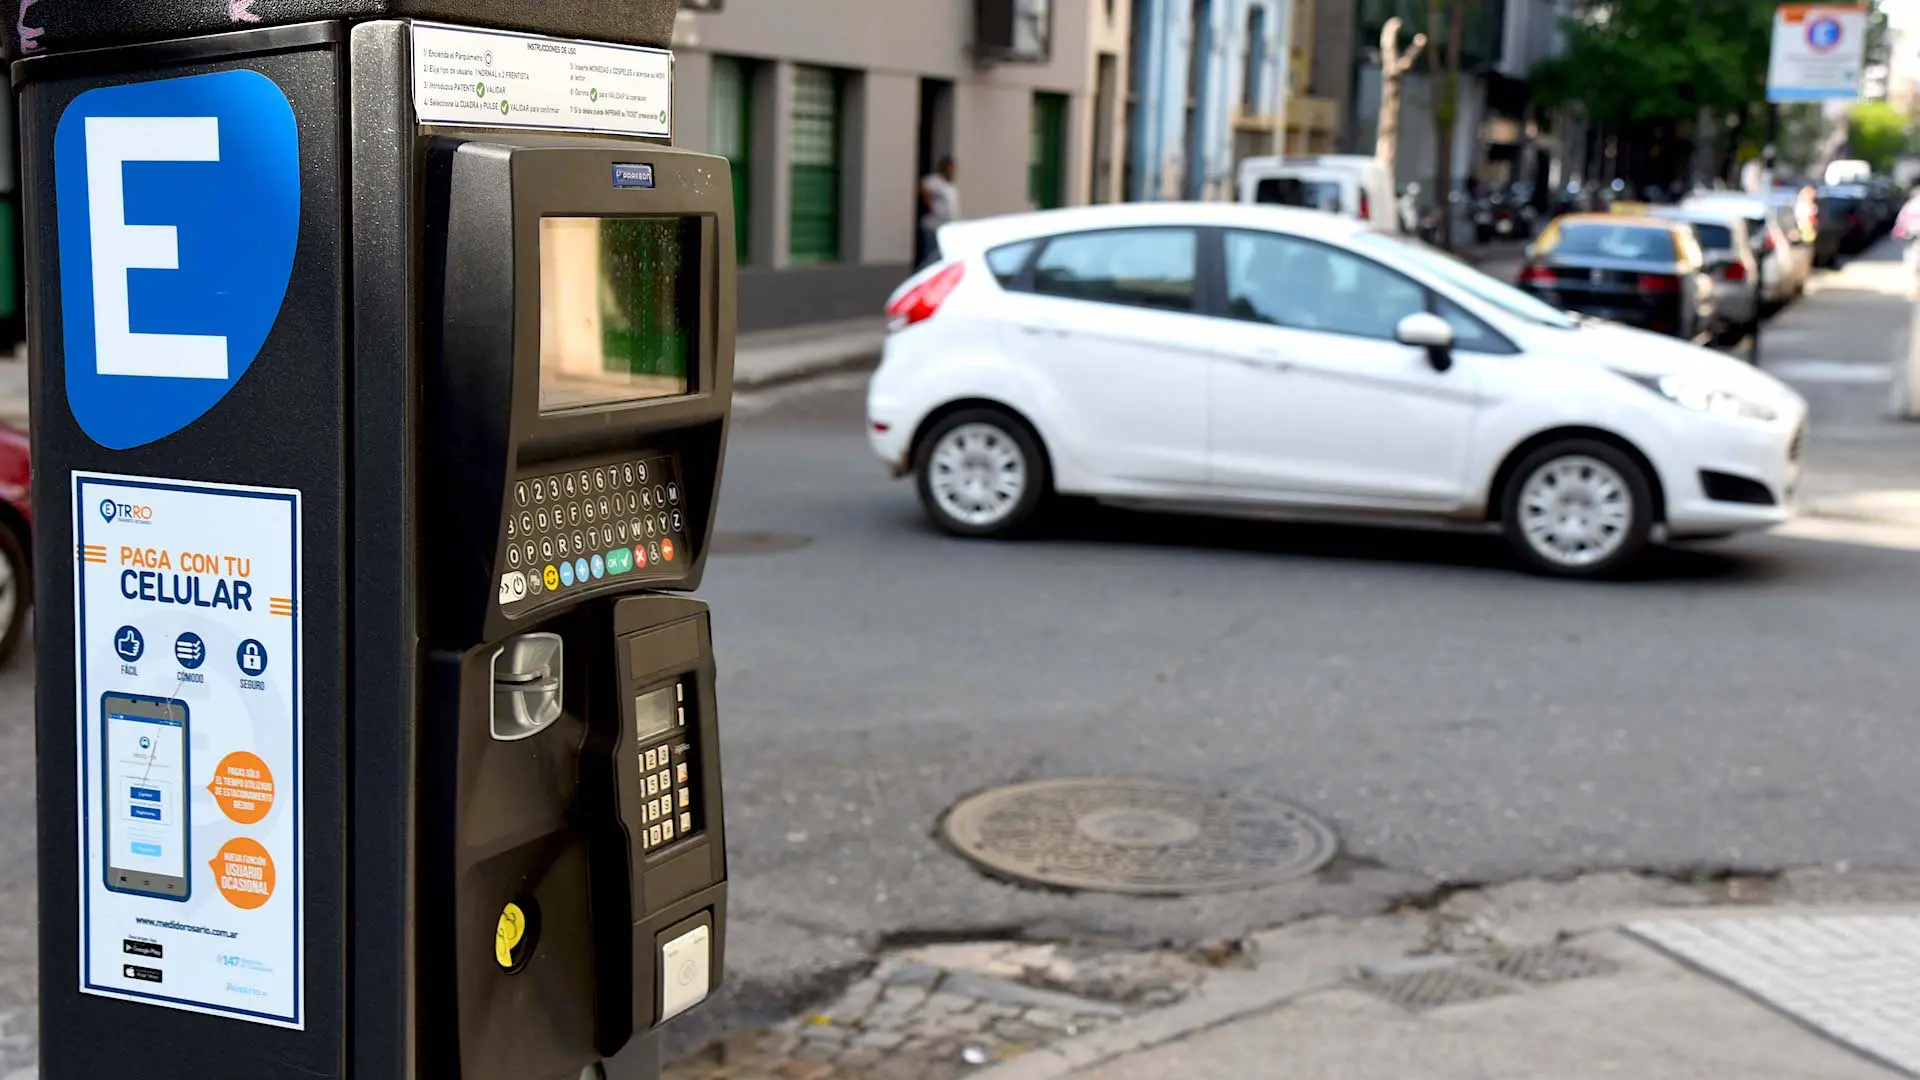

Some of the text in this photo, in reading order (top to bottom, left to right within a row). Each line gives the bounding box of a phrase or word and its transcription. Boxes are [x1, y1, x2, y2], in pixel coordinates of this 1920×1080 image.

[561, 46, 567, 54] DE
[506, 71, 529, 80] FRENTISTA
[454, 83, 475, 92] PATENTE
[460, 100, 479, 109] CUADRA
[483, 102, 498, 110] PULSE
[84, 116, 229, 380] E
[520, 465, 646, 502] 1 2 3 4 5 6 7 8 9
[523, 517, 531, 530] C
[540, 514, 547, 527] D
[555, 510, 562, 524] E
[571, 507, 577, 521] F
[585, 504, 594, 518] G
[600, 501, 608, 515] H
[630, 496, 636, 509] J
[642, 493, 650, 506] K
[657, 490, 663, 503] L
[669, 487, 677, 500] M
[510, 514, 681, 563] O P Q R S T U V W X Y Z
[120, 547, 251, 578] PAGA CON TU
[120, 569, 252, 612] CELULAR
[240, 679, 265, 690] SEGURO
[226, 863, 263, 880] USUARIO
[221, 876, 270, 896] OCASIONAL
